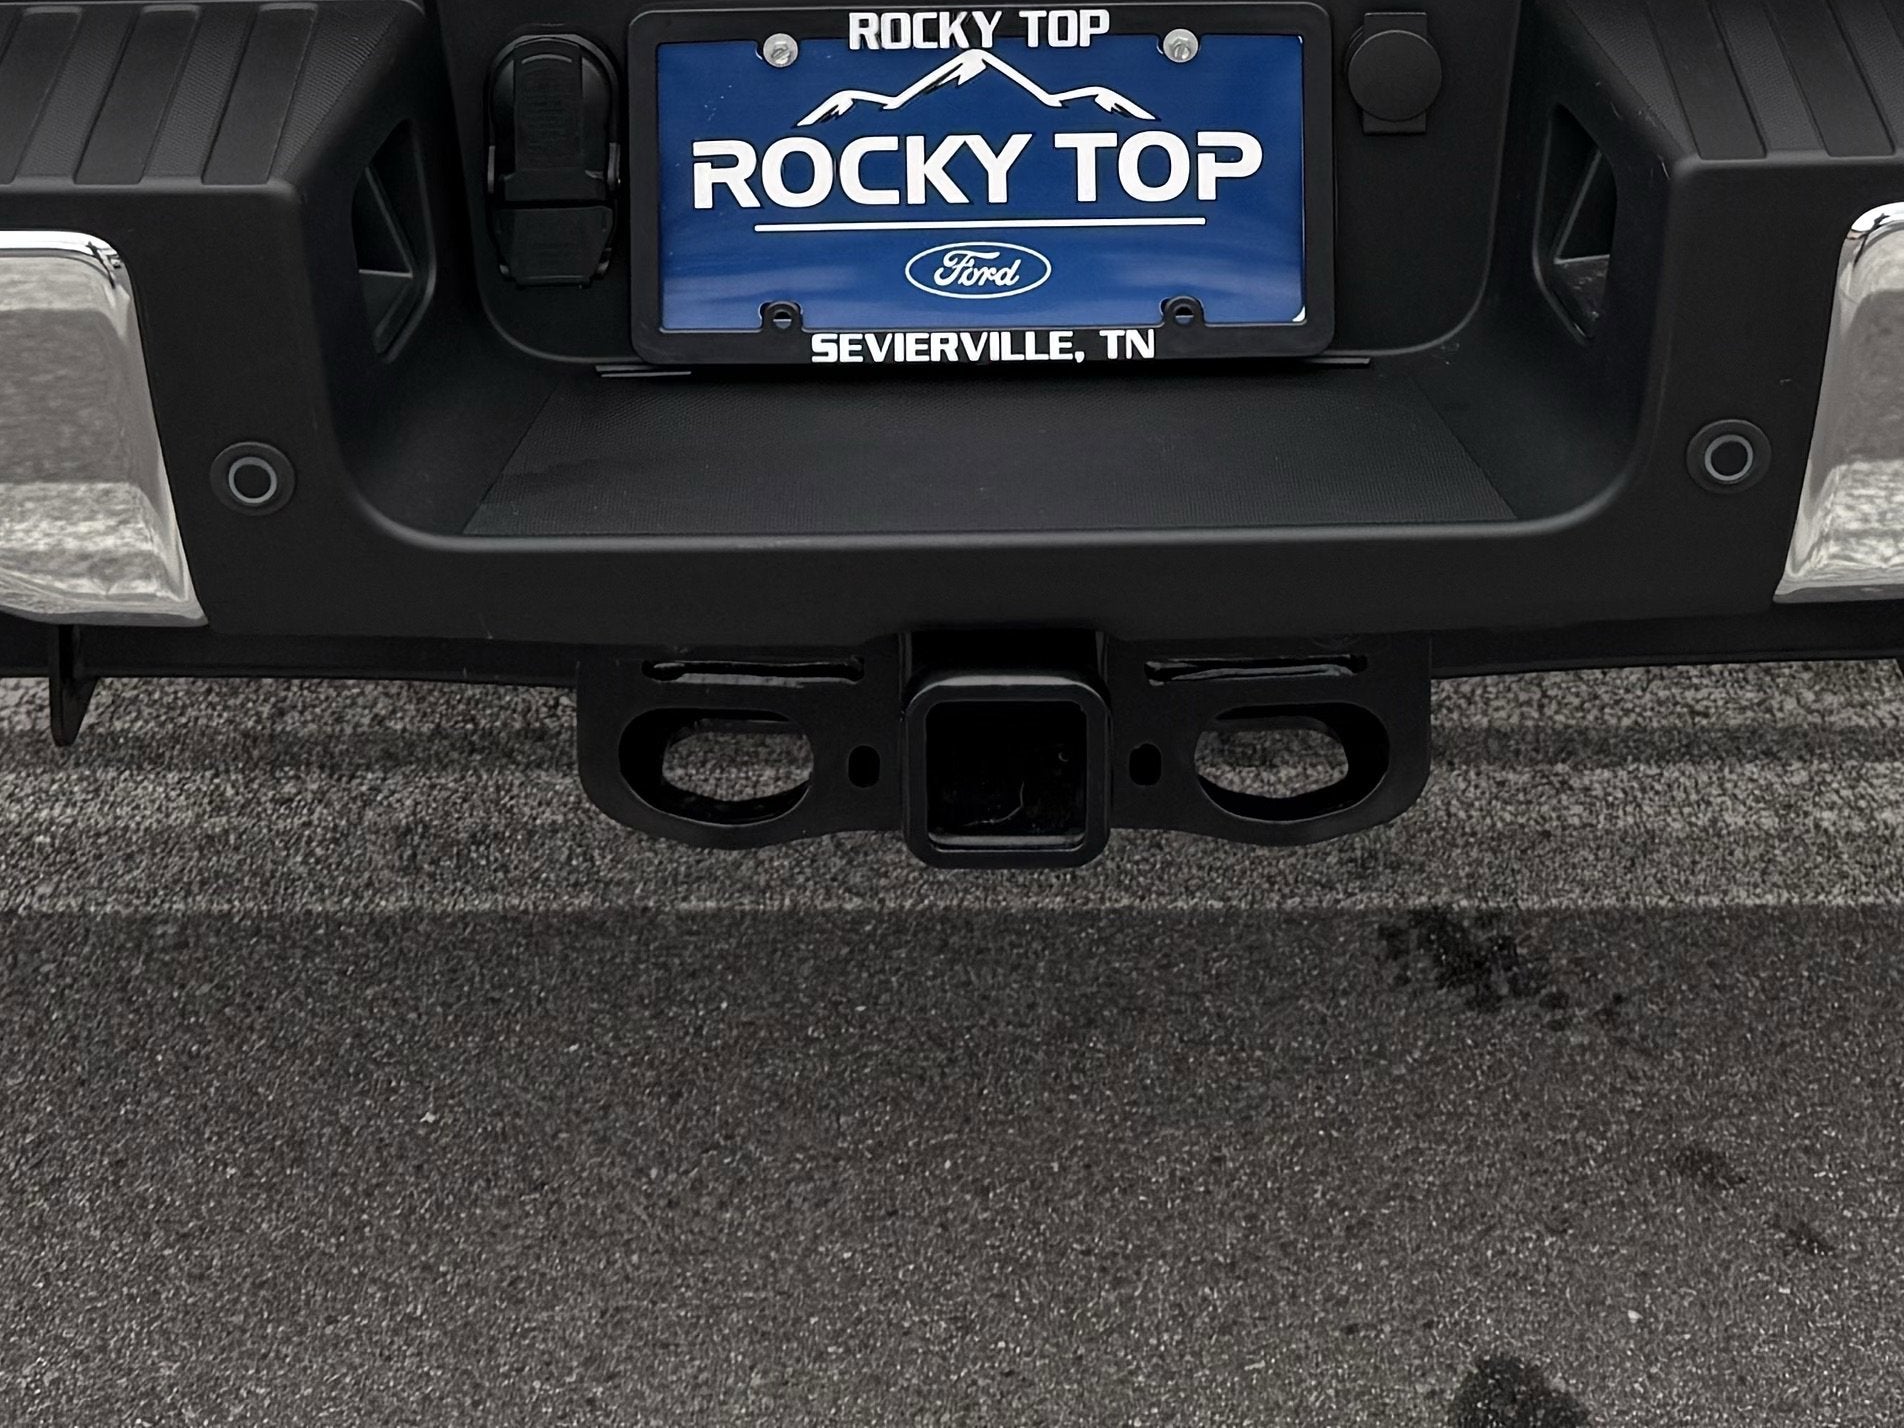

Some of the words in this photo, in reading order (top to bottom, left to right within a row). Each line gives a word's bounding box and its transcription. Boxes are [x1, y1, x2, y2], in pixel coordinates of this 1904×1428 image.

[849, 10, 1002, 50] ROCKY
[1019, 9, 1110, 47] TOP
[693, 133, 1032, 209] ROCKY
[1055, 131, 1263, 202] TOP
[933, 251, 1019, 287] Ford
[811, 330, 1085, 363] SEVIERVILLE,
[1100, 328, 1155, 359] TN
